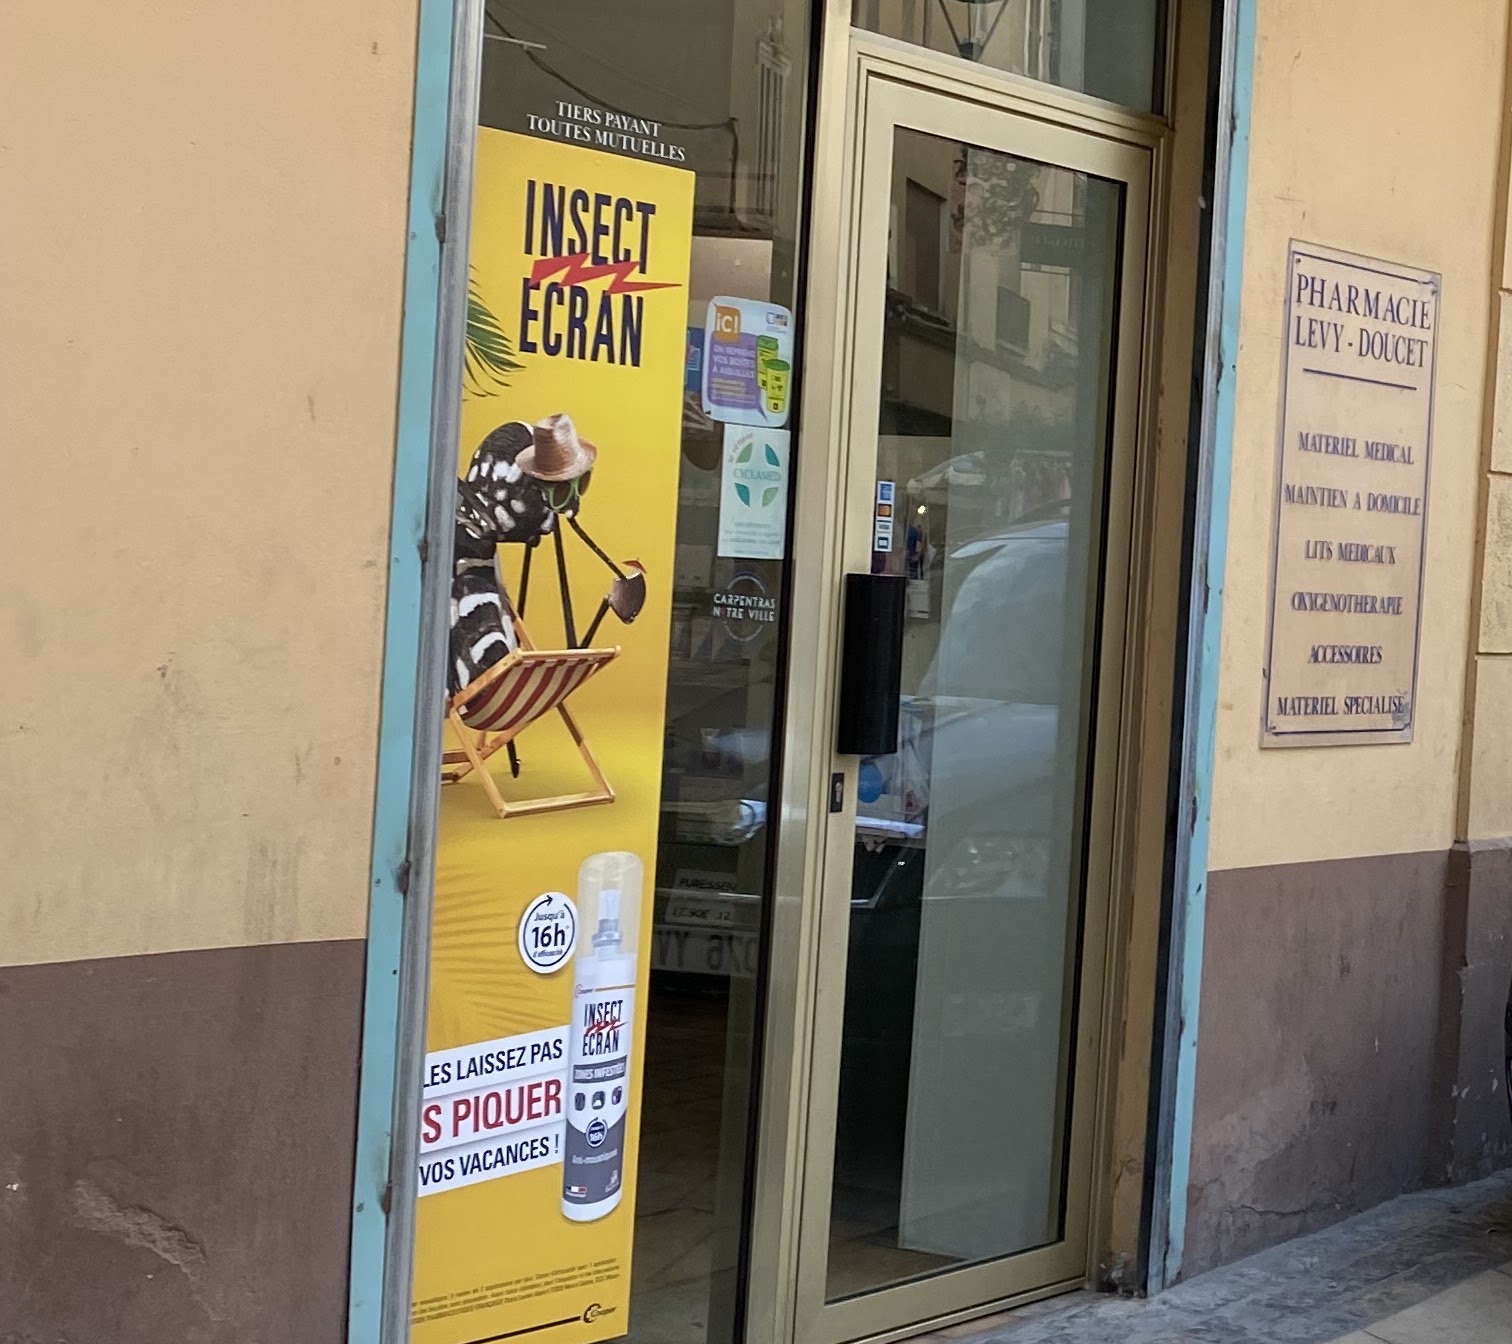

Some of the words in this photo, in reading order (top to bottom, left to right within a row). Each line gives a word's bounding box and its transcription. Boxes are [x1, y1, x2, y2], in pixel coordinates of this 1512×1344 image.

[555, 100, 601, 125] TIERS
[604, 112, 662, 137] PAYANT
[527, 114, 591, 142] TOUTES
[595, 129, 685, 161] MUTUELLES
[524, 179, 656, 274] INSECT
[1296, 272, 1431, 330] PHARMACIE
[520, 277, 643, 367] ECRAN
[1295, 315, 1344, 352] LEVY
[1358, 328, 1429, 368] DOUCET
[1299, 431, 1360, 458] MATERIEL
[1364, 440, 1415, 465] MEDICAL
[1284, 484, 1348, 508] MAINTIEN
[1352, 492, 1361, 510] A
[1367, 492, 1421, 516] DOMICILE
[1305, 539, 1333, 560] LITS
[1338, 542, 1396, 565] MEDICAUX
[713, 593, 776, 609] CARPENTRAS
[748, 609, 775, 622] VILLE
[1291, 591, 1403, 615] OXYGENOTHERAPIE
[1308, 644, 1383, 664] ACCESSOIRES
[1277, 696, 1339, 716] MATERIEL
[1343, 695, 1404, 715] SPECIALISE
[584, 1000, 623, 1027] INSECT
[457, 1046, 526, 1081] LAISSEZ
[530, 1038, 563, 1064] PAS
[583, 1029, 620, 1057] ECRAN
[452, 1078, 562, 1138] PIQUER
[419, 1158, 455, 1186] VOS
[459, 1136, 550, 1176] VACANCES
